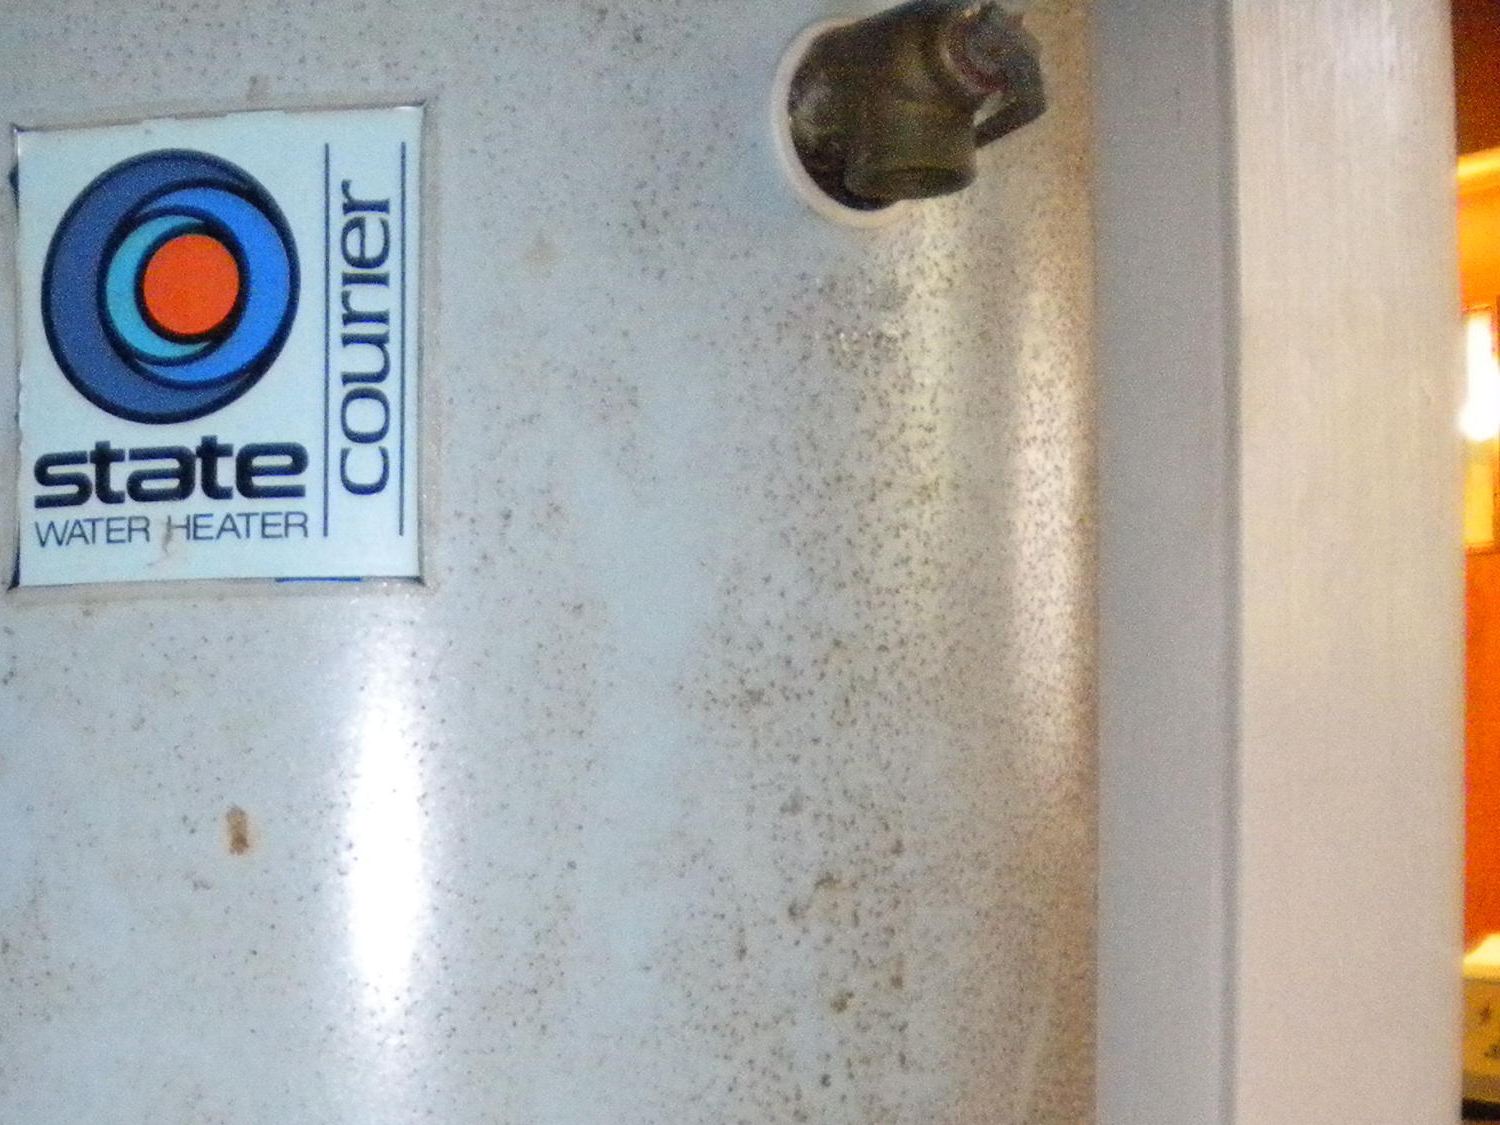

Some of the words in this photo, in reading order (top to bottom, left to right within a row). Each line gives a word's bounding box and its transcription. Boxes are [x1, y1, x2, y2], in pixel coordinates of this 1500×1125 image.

[340, 179, 391, 496] courier
[34, 435, 309, 509] state
[35, 515, 150, 548] WATER
[166, 511, 309, 541] HEATER
